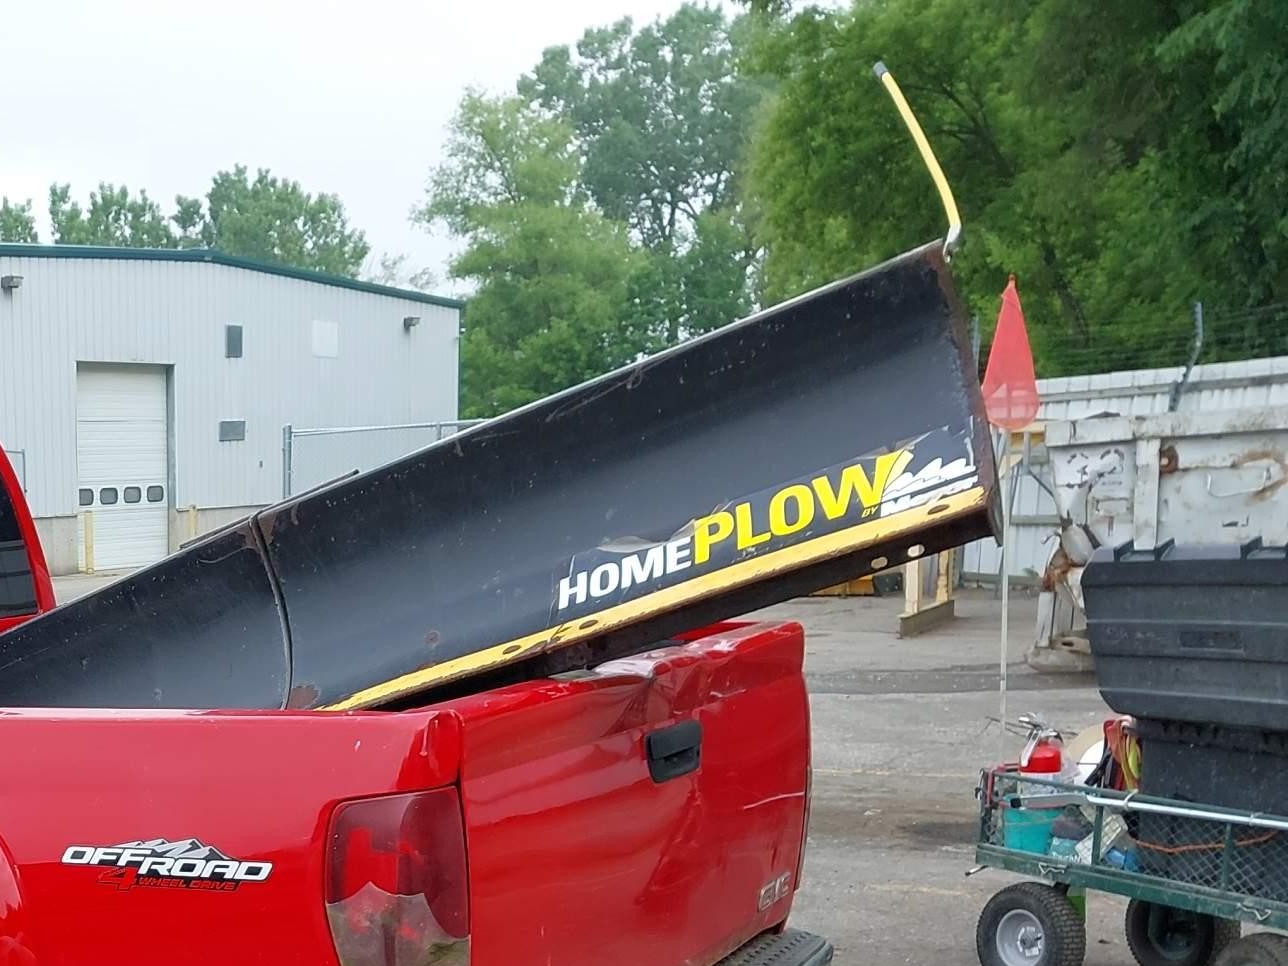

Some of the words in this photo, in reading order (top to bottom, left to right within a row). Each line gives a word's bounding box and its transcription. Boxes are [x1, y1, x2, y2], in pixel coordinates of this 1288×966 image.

[862, 506, 879, 518] BY
[139, 876, 187, 889] WHEEL
[188, 879, 236, 891] DRIVE
